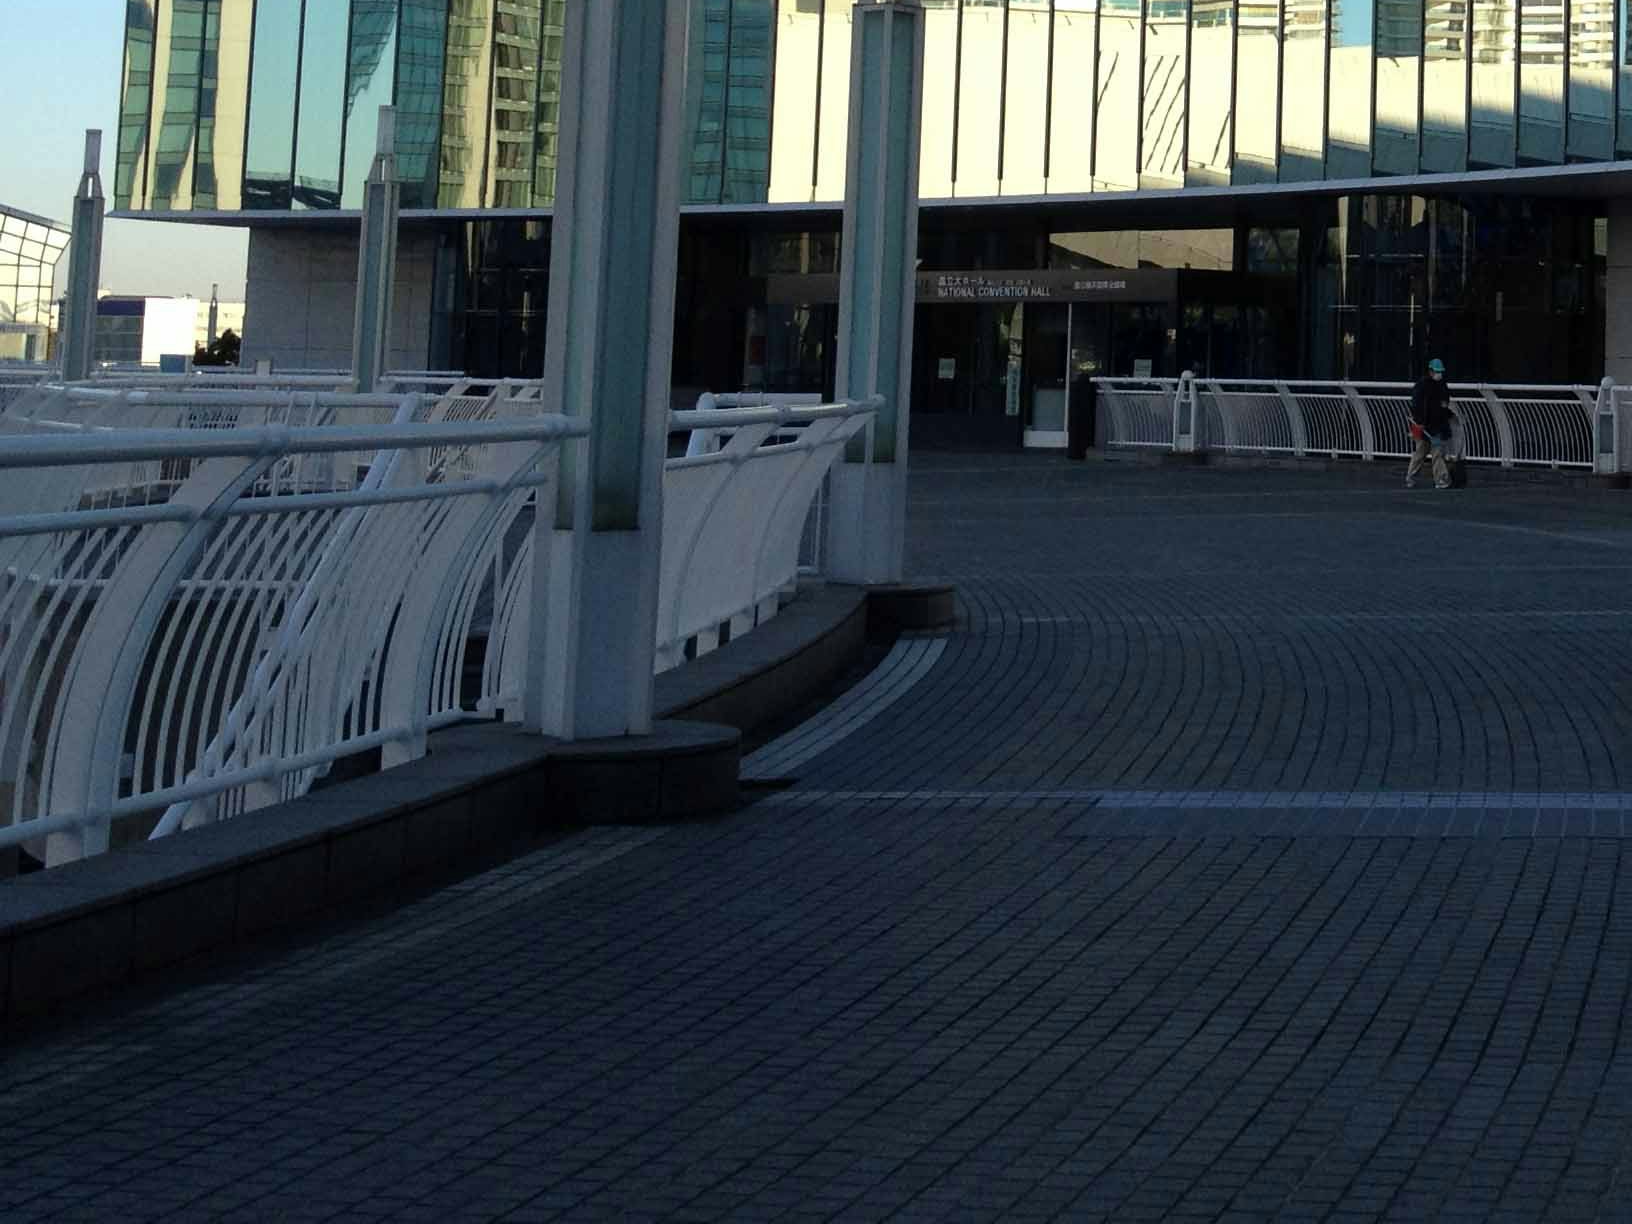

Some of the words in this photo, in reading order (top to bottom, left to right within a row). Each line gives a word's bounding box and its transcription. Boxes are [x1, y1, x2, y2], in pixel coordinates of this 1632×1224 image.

[938, 287, 975, 297] NATIONAL
[978, 287, 1028, 297] CONVENTION
[1031, 287, 1051, 297] HALL
